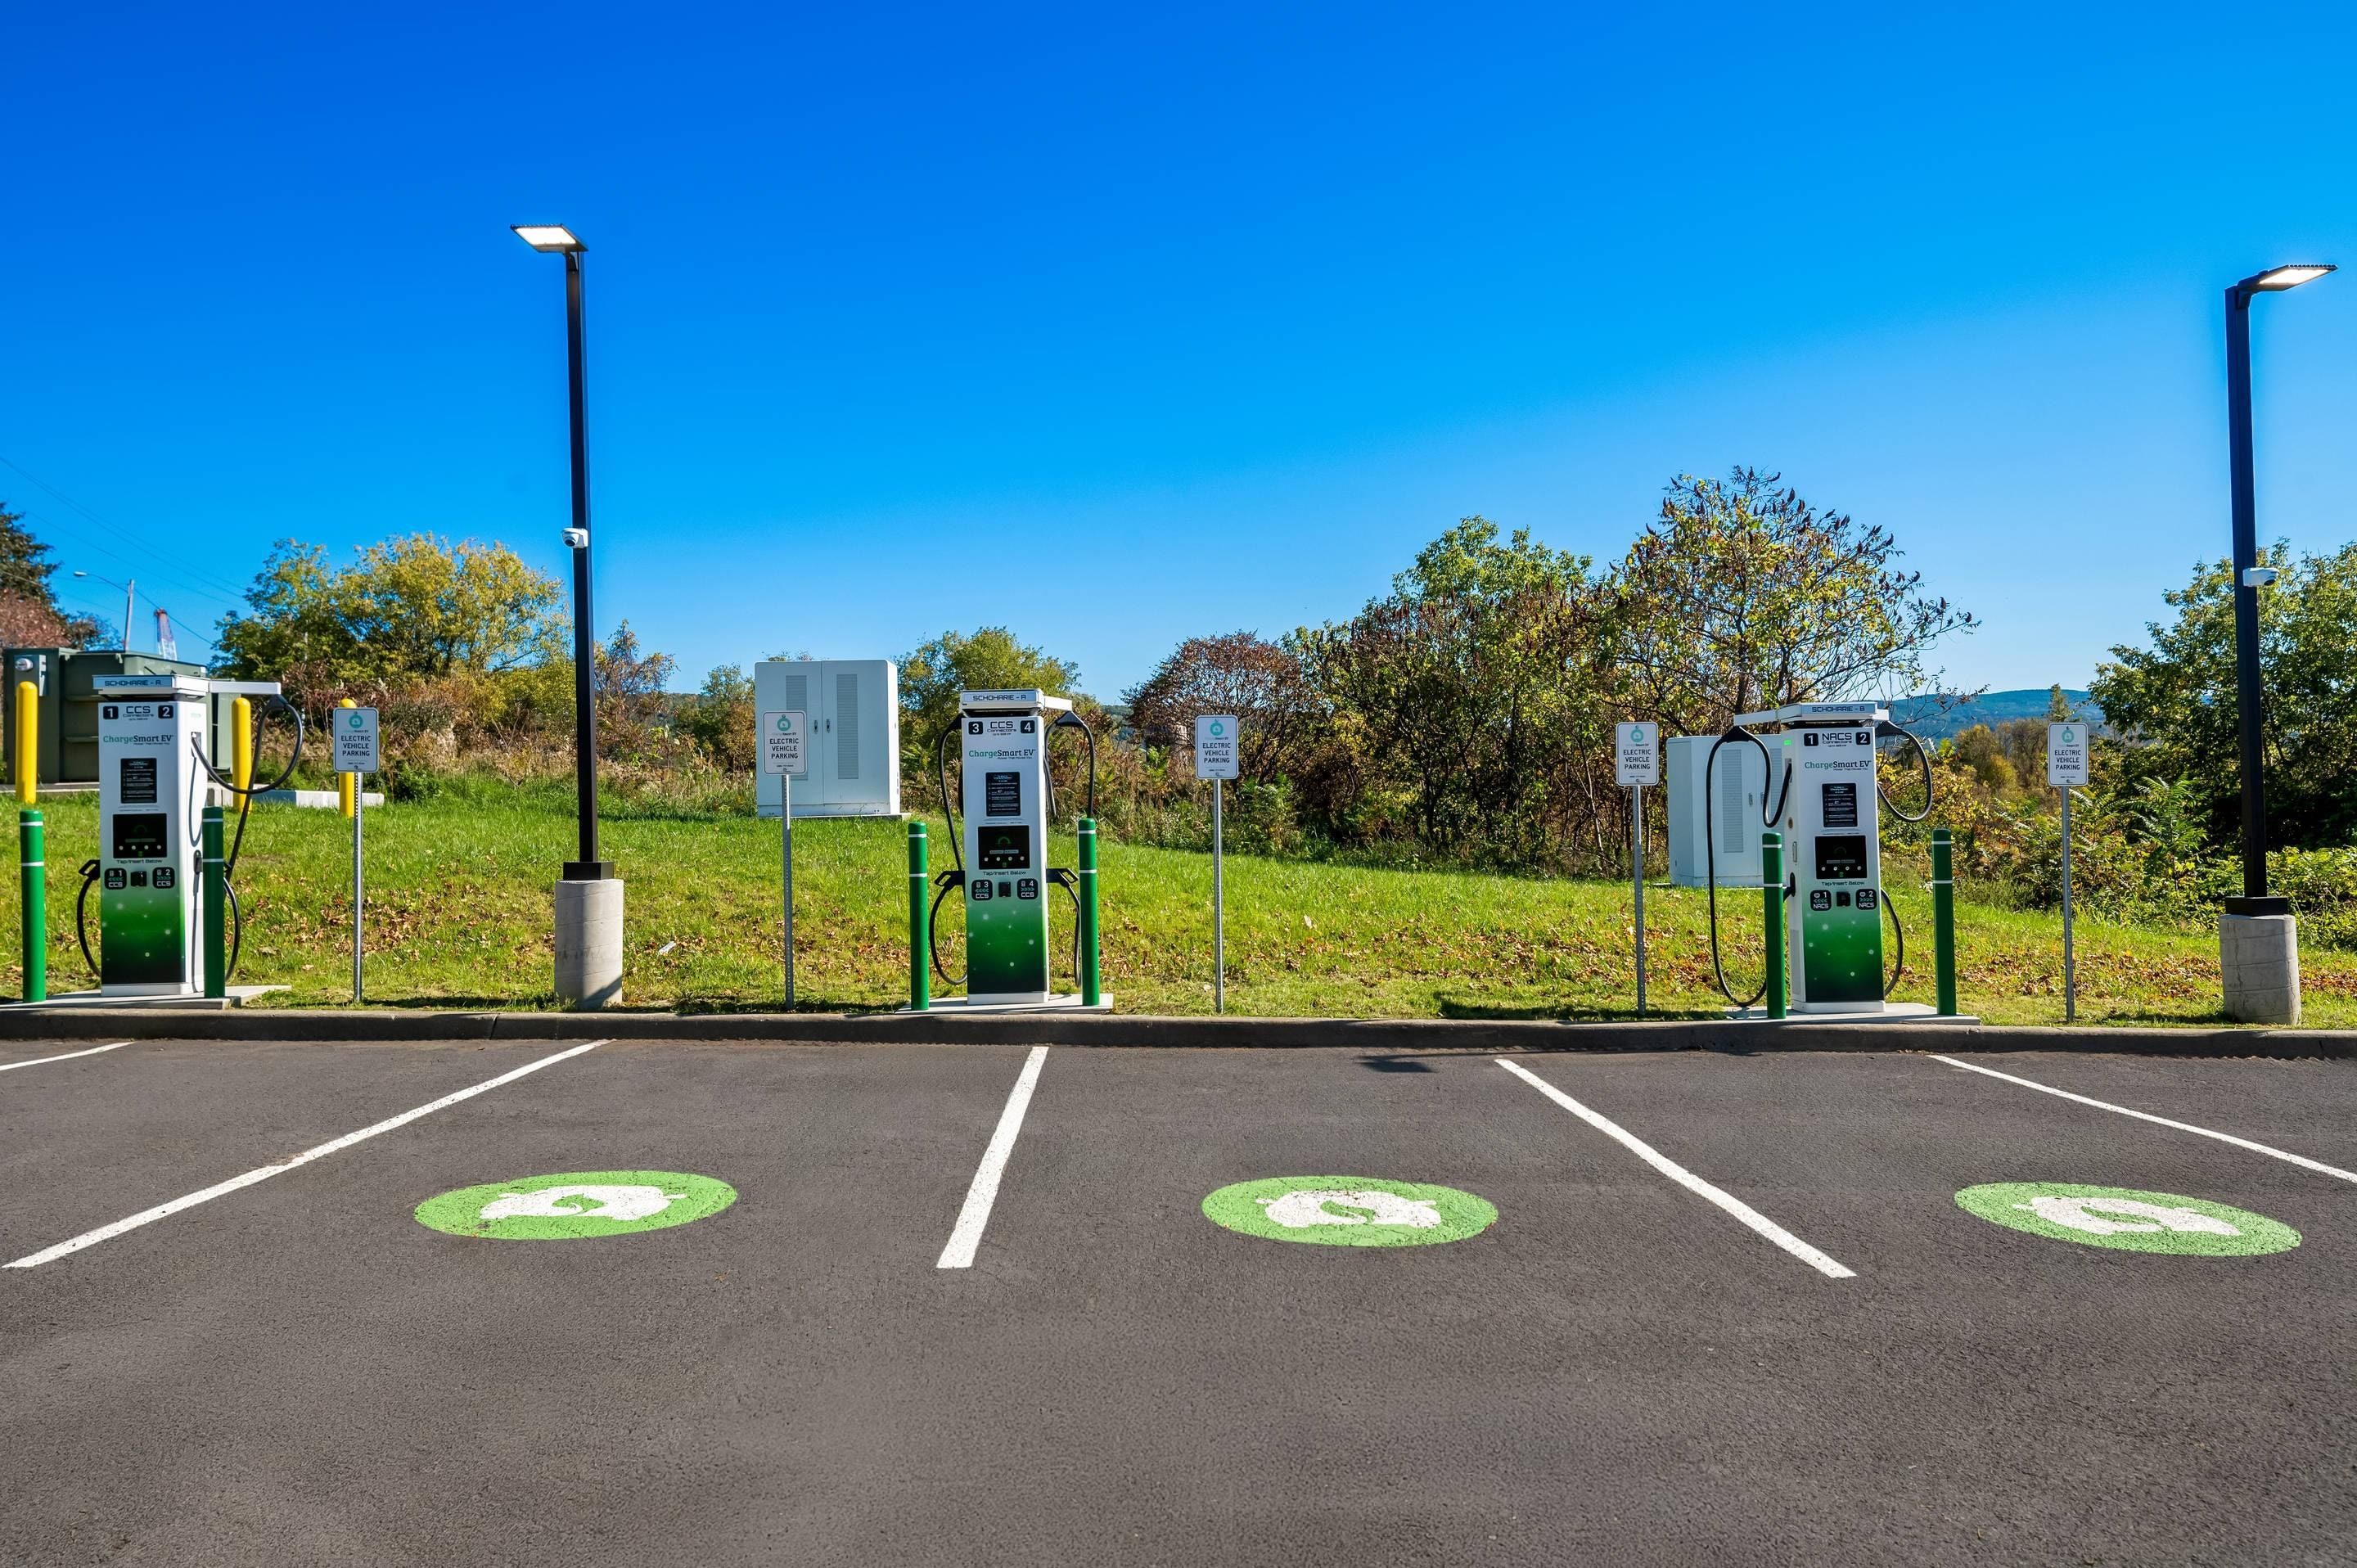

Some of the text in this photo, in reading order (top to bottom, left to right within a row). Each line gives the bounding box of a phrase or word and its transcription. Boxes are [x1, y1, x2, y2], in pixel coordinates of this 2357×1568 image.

[107, 708, 114, 718] 1
[126, 705, 151, 714] CCS
[162, 706, 170, 717] 2
[972, 723, 980, 732] 3
[1024, 722, 1032, 732] 4
[103, 735, 159, 744] ChargeSmart
[1808, 735, 1814, 745] 1
[1822, 732, 1852, 741] NACS
[1860, 733, 1867, 743] 2
[969, 750, 1021, 759] ChargeSmart
[1805, 761, 1858, 769] ChargeSmart
